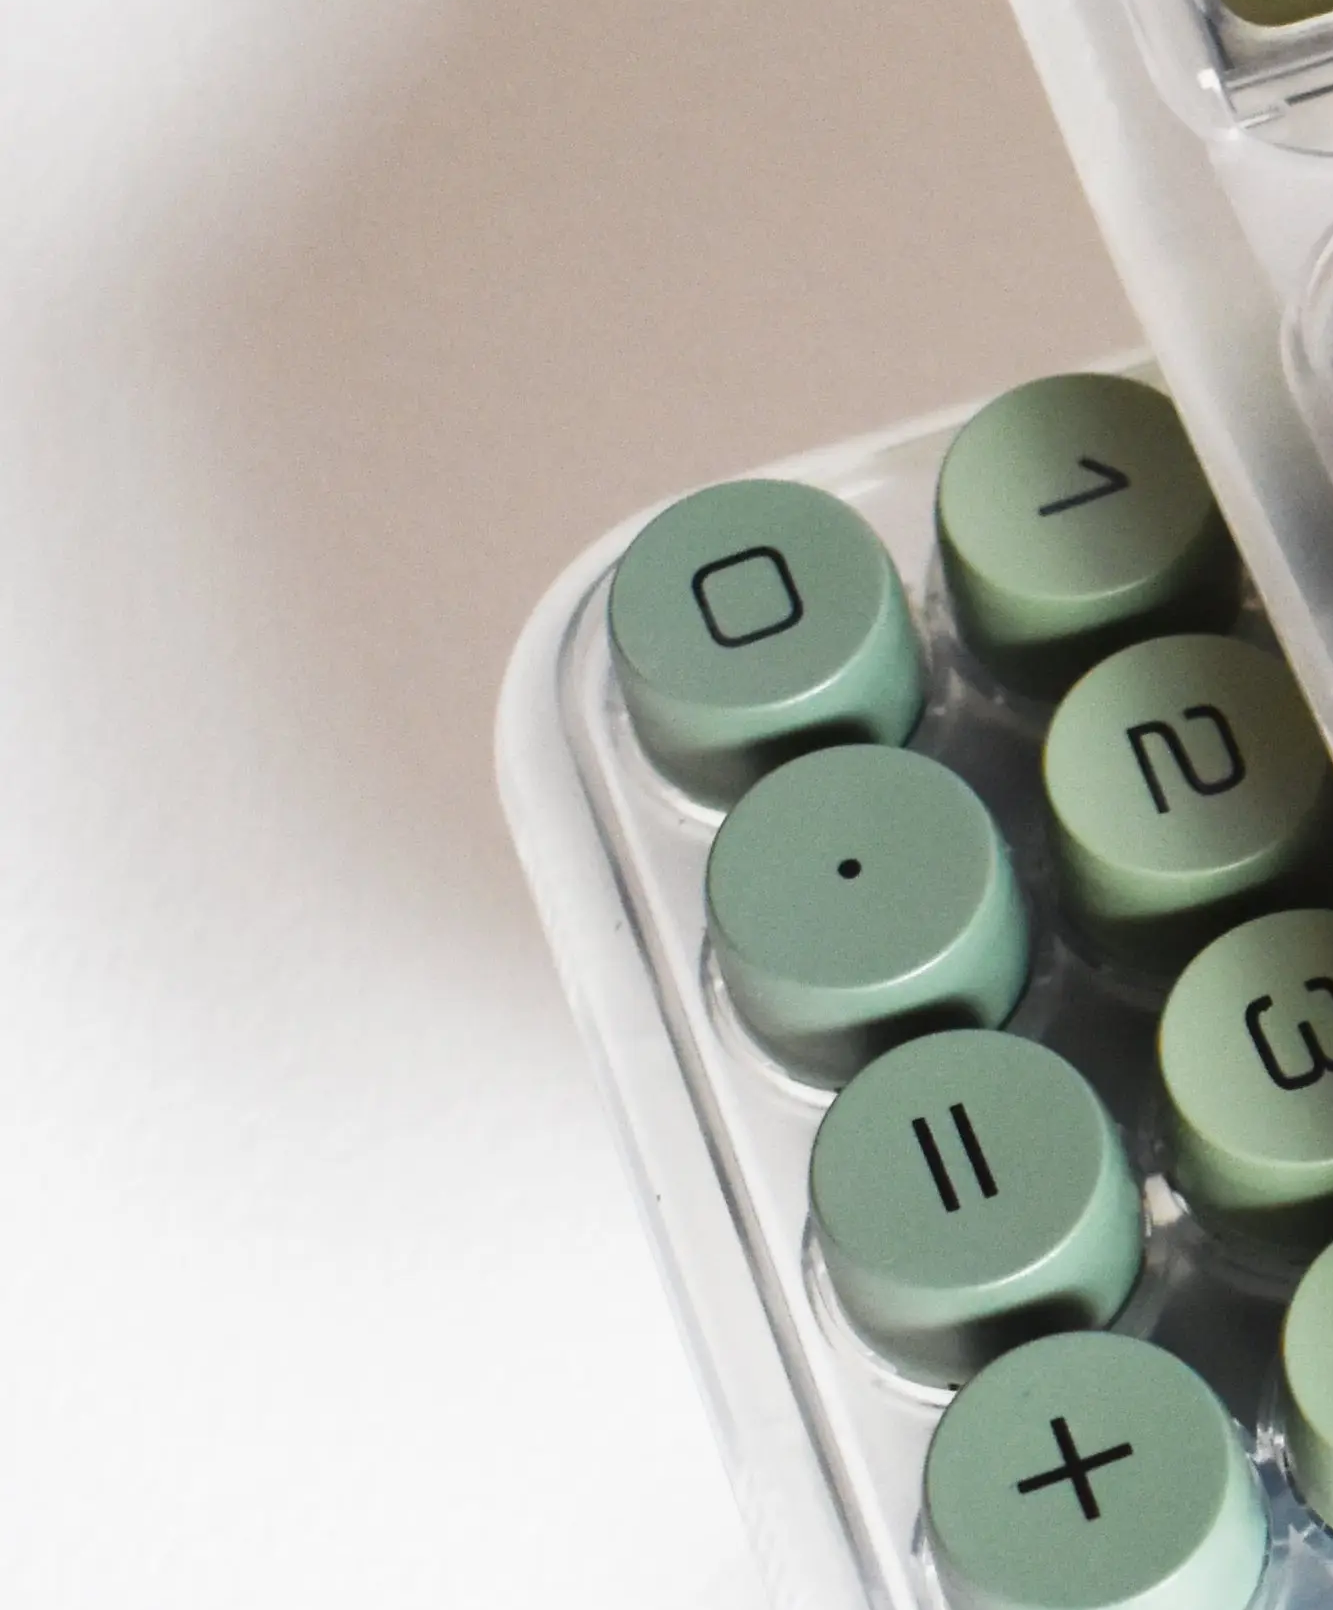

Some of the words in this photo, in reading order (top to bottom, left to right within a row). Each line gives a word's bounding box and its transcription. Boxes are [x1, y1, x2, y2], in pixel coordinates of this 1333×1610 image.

[1040, 457, 1131, 515] 1
[692, 546, 803, 647] 0
[1127, 704, 1246, 813] 2
